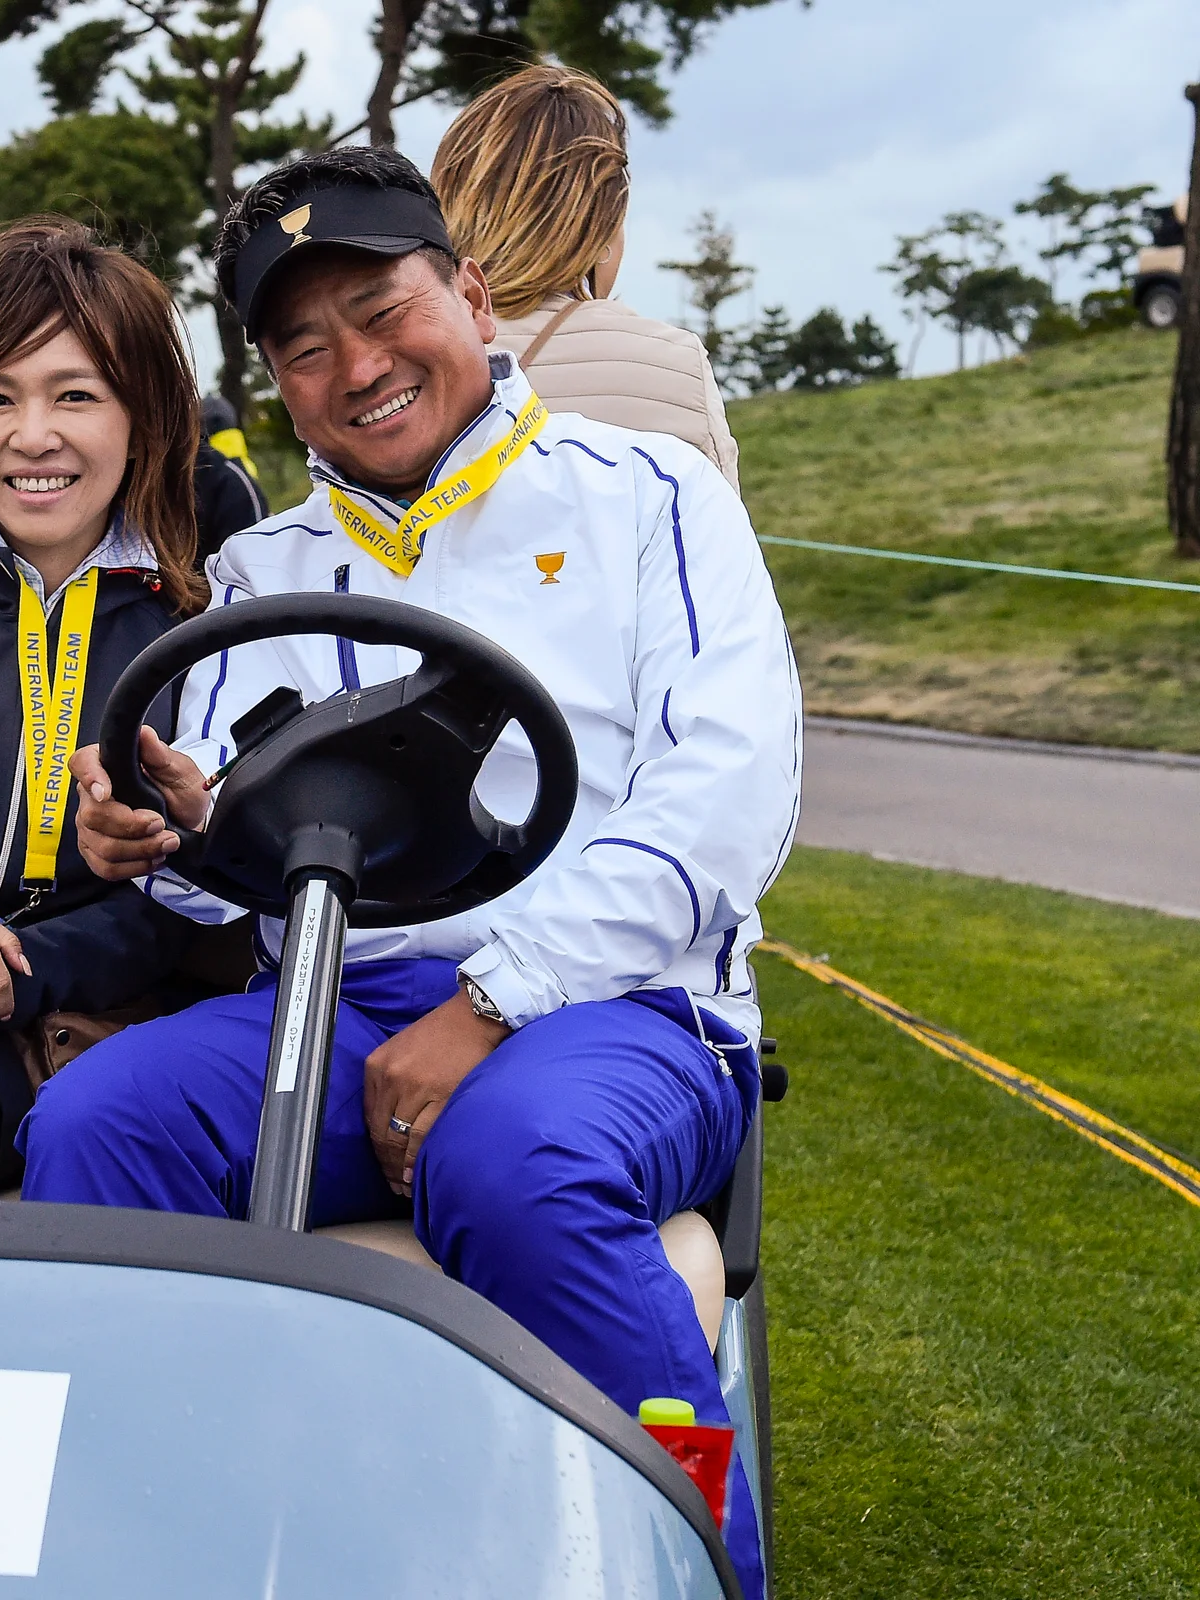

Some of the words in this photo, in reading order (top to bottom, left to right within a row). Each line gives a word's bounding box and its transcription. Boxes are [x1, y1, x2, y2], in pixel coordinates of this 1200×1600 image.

[430, 479, 472, 511] TEAM
[38, 686, 76, 835] INTERNATIONAL
[63, 633, 82, 682] TEAM
